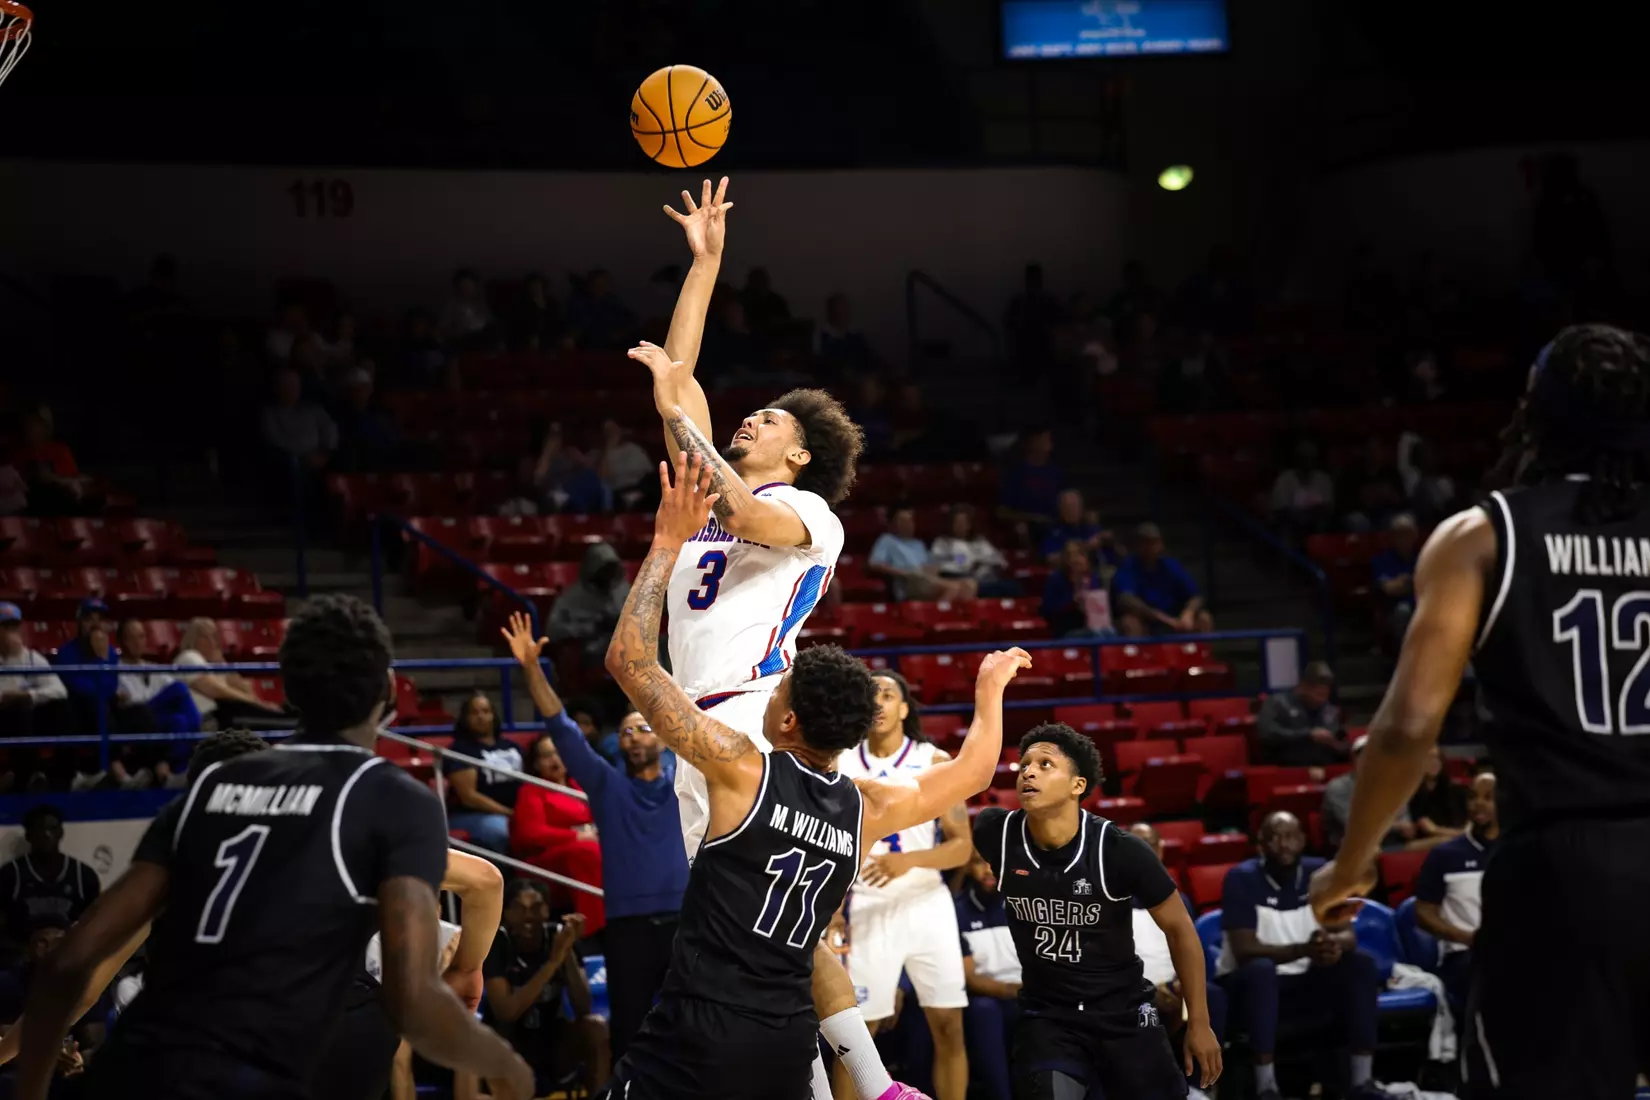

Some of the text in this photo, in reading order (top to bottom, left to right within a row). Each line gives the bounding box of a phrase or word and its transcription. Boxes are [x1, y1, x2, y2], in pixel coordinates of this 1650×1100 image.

[285, 179, 353, 217] 119
[687, 550, 728, 611] 3
[1553, 588, 1650, 735] 12
[769, 803, 789, 833] M.
[791, 811, 853, 857] WILLIAMS
[195, 823, 271, 943] 1
[752, 846, 836, 949] 11
[1006, 896, 1101, 926] TIGERS
[1034, 925, 1082, 963] 24
